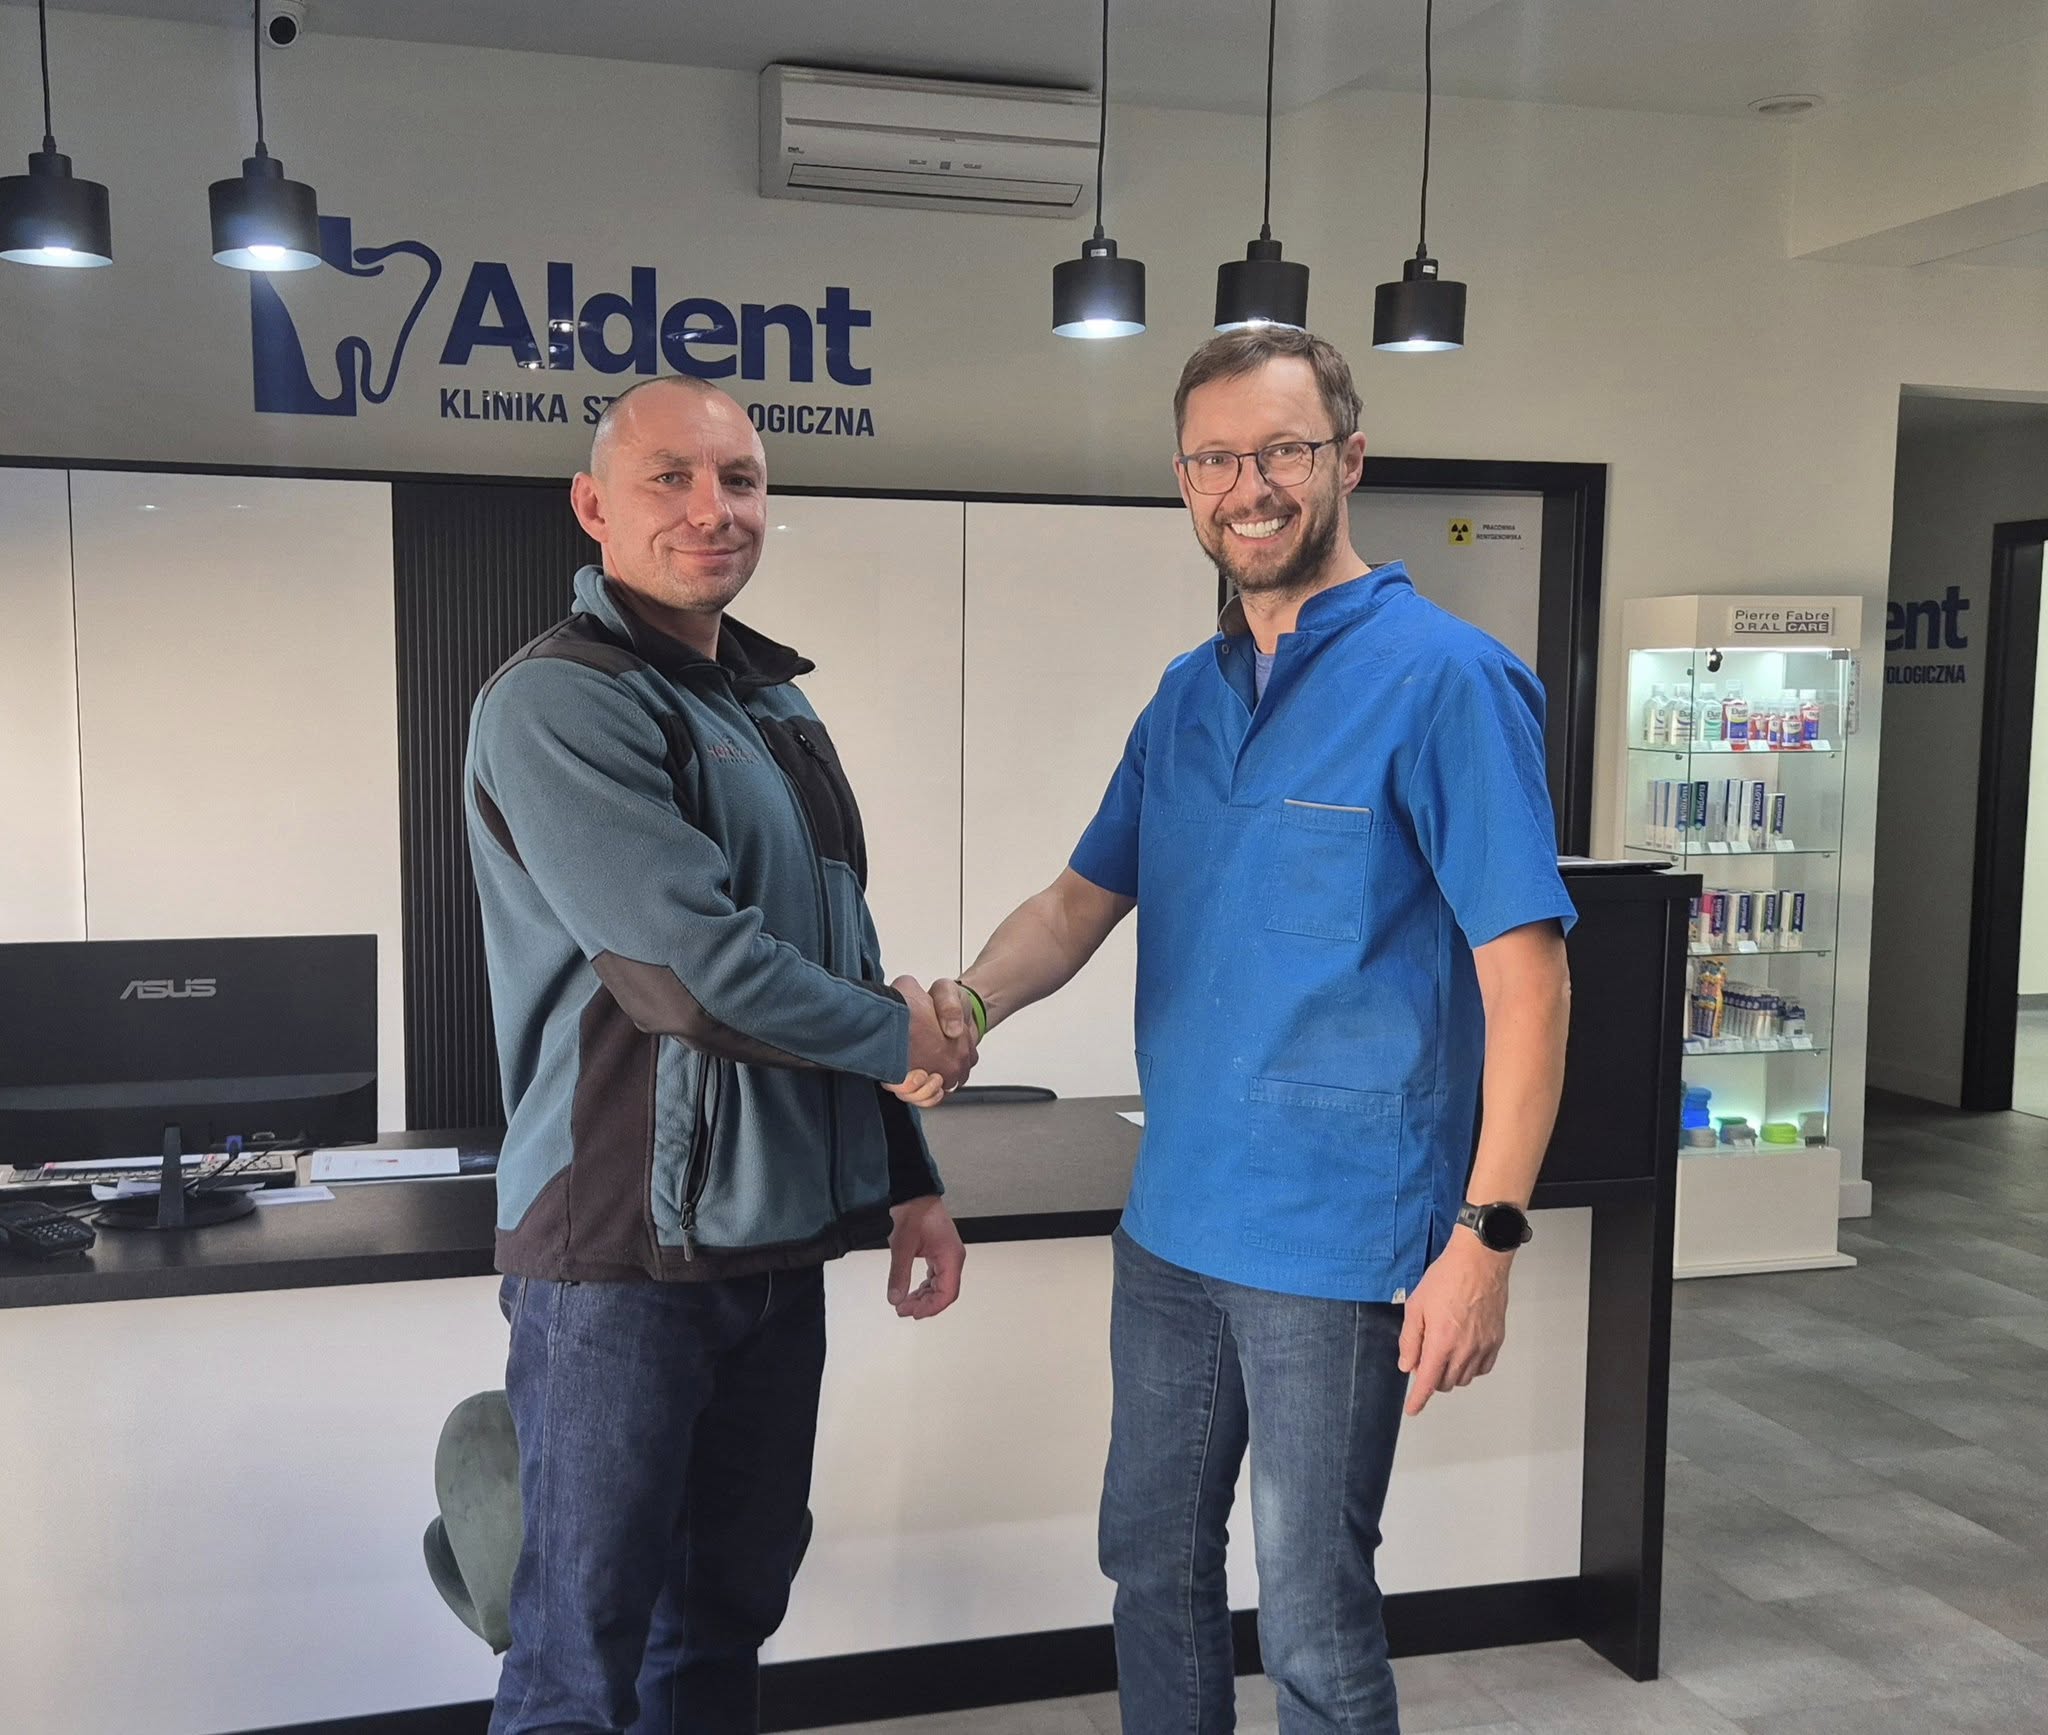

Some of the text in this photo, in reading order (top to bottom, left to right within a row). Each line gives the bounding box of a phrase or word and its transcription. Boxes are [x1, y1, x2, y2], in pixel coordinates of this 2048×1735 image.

[439, 261, 871, 386] Aldent
[440, 388, 875, 437] KLINIKA SOGICZNA
[1735, 609, 1830, 621] Pierre Fabre
[1885, 585, 1970, 652] ent
[1734, 622, 1828, 632] ORAL CARE
[1886, 664, 1967, 685] OLOGICZNA
[120, 978, 217, 999] ASUS
